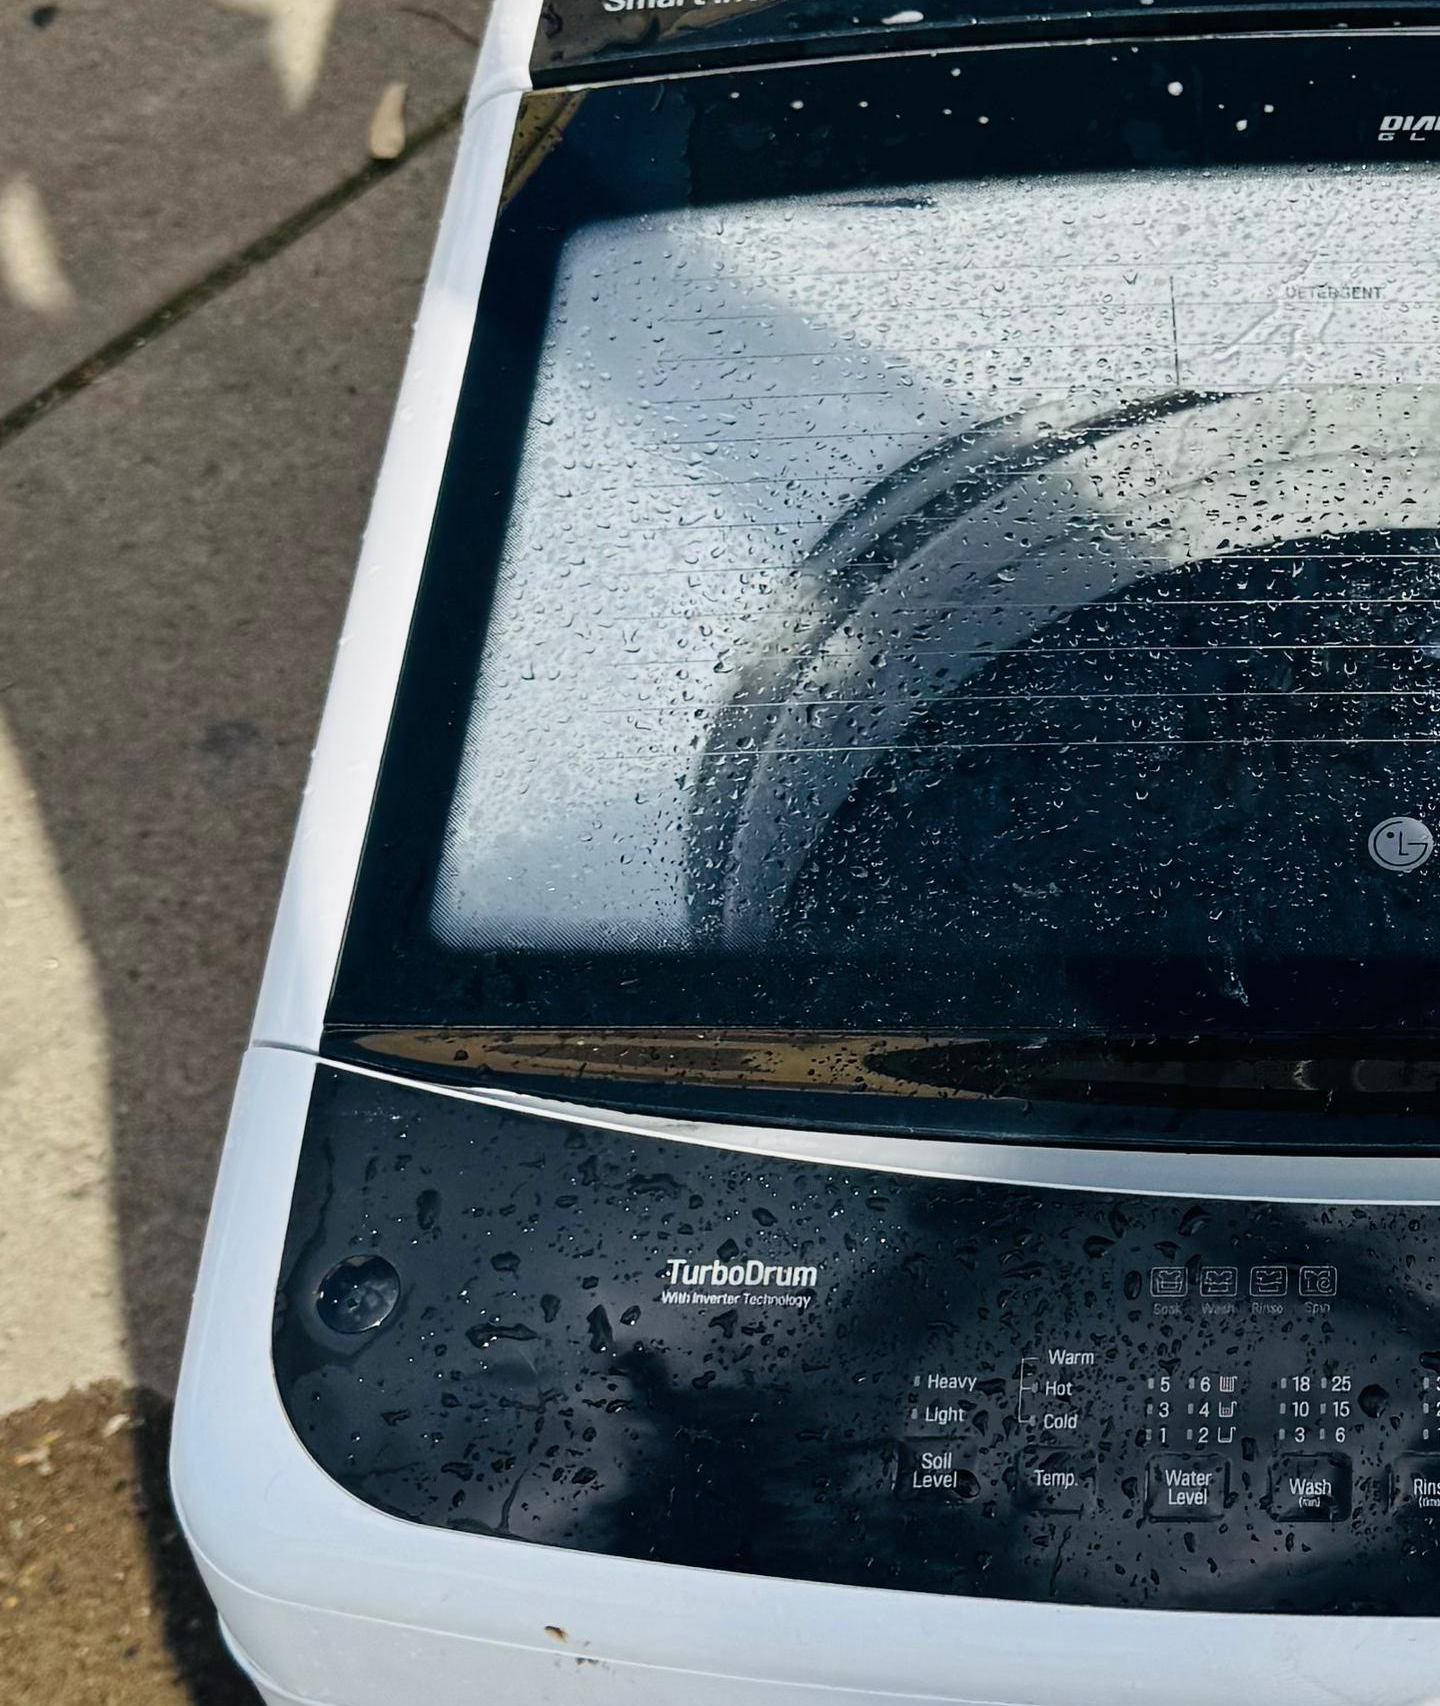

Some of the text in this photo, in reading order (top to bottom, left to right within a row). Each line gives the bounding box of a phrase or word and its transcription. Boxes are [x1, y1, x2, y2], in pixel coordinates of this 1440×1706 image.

[666, 1259, 818, 1287] TurboDrum
[661, 1291, 811, 1309] With Inverter Technology
[1049, 1350, 1094, 1365] Warm
[927, 1374, 977, 1392] Heavy
[1045, 1381, 1073, 1397] Hot
[1160, 1377, 1210, 1392] 5 6
[1292, 1376, 1351, 1392] 18 25
[925, 1407, 965, 1425] Light
[1159, 1402, 1210, 1417] 3 4
[1292, 1402, 1350, 1417] 10 15
[1044, 1414, 1078, 1429] Cold
[1159, 1428, 1209, 1442] 1 2
[1295, 1428, 1345, 1443] 3 6
[921, 1452, 952, 1469] Soil
[913, 1469, 957, 1488] Level
[1034, 1470, 1078, 1489] Temp.
[1165, 1469, 1212, 1487] Water
[1289, 1478, 1332, 1495] Wash
[1168, 1488, 1208, 1506] Level
